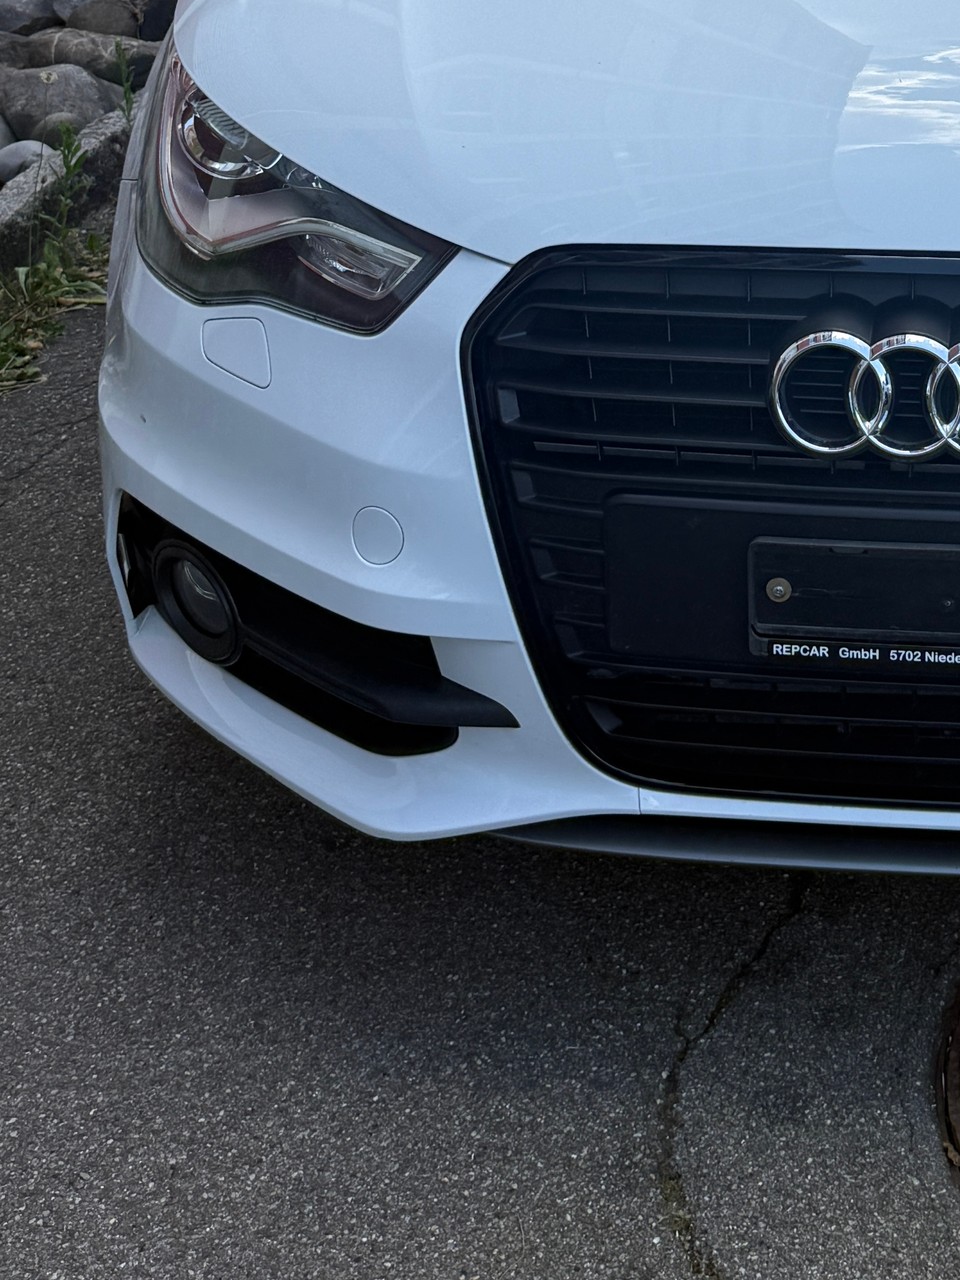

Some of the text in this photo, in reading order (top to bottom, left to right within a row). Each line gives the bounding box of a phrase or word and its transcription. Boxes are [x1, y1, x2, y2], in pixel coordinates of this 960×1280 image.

[773, 643, 829, 658] REPCAR
[838, 647, 880, 660] GmbH
[889, 650, 922, 662] 5702
